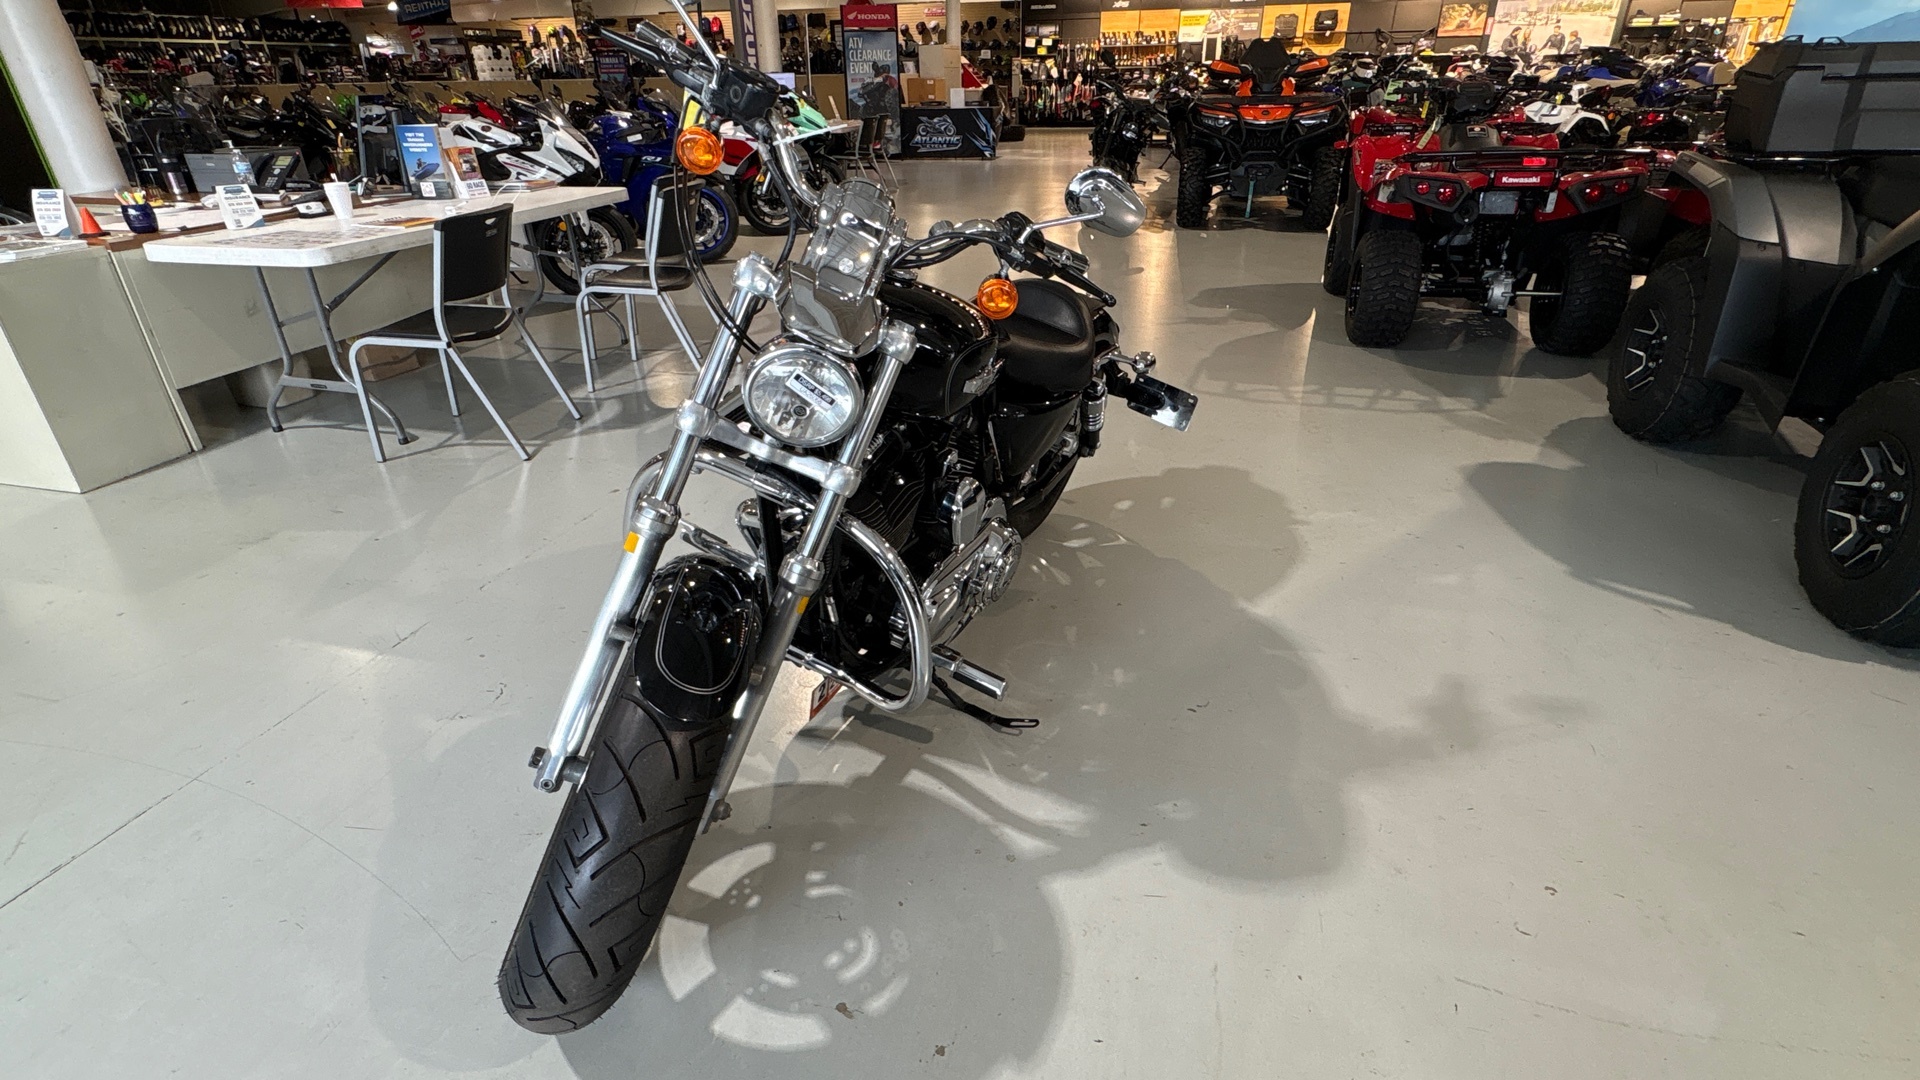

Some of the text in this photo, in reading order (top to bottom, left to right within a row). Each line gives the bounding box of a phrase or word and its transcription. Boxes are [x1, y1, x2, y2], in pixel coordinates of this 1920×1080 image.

[404, 1, 447, 13] RENTHAL
[848, 37, 863, 49] ATV
[849, 50, 892, 61] CLEARANCE
[850, 62, 874, 74] EVENT
[913, 135, 962, 144] ATLANTIC
